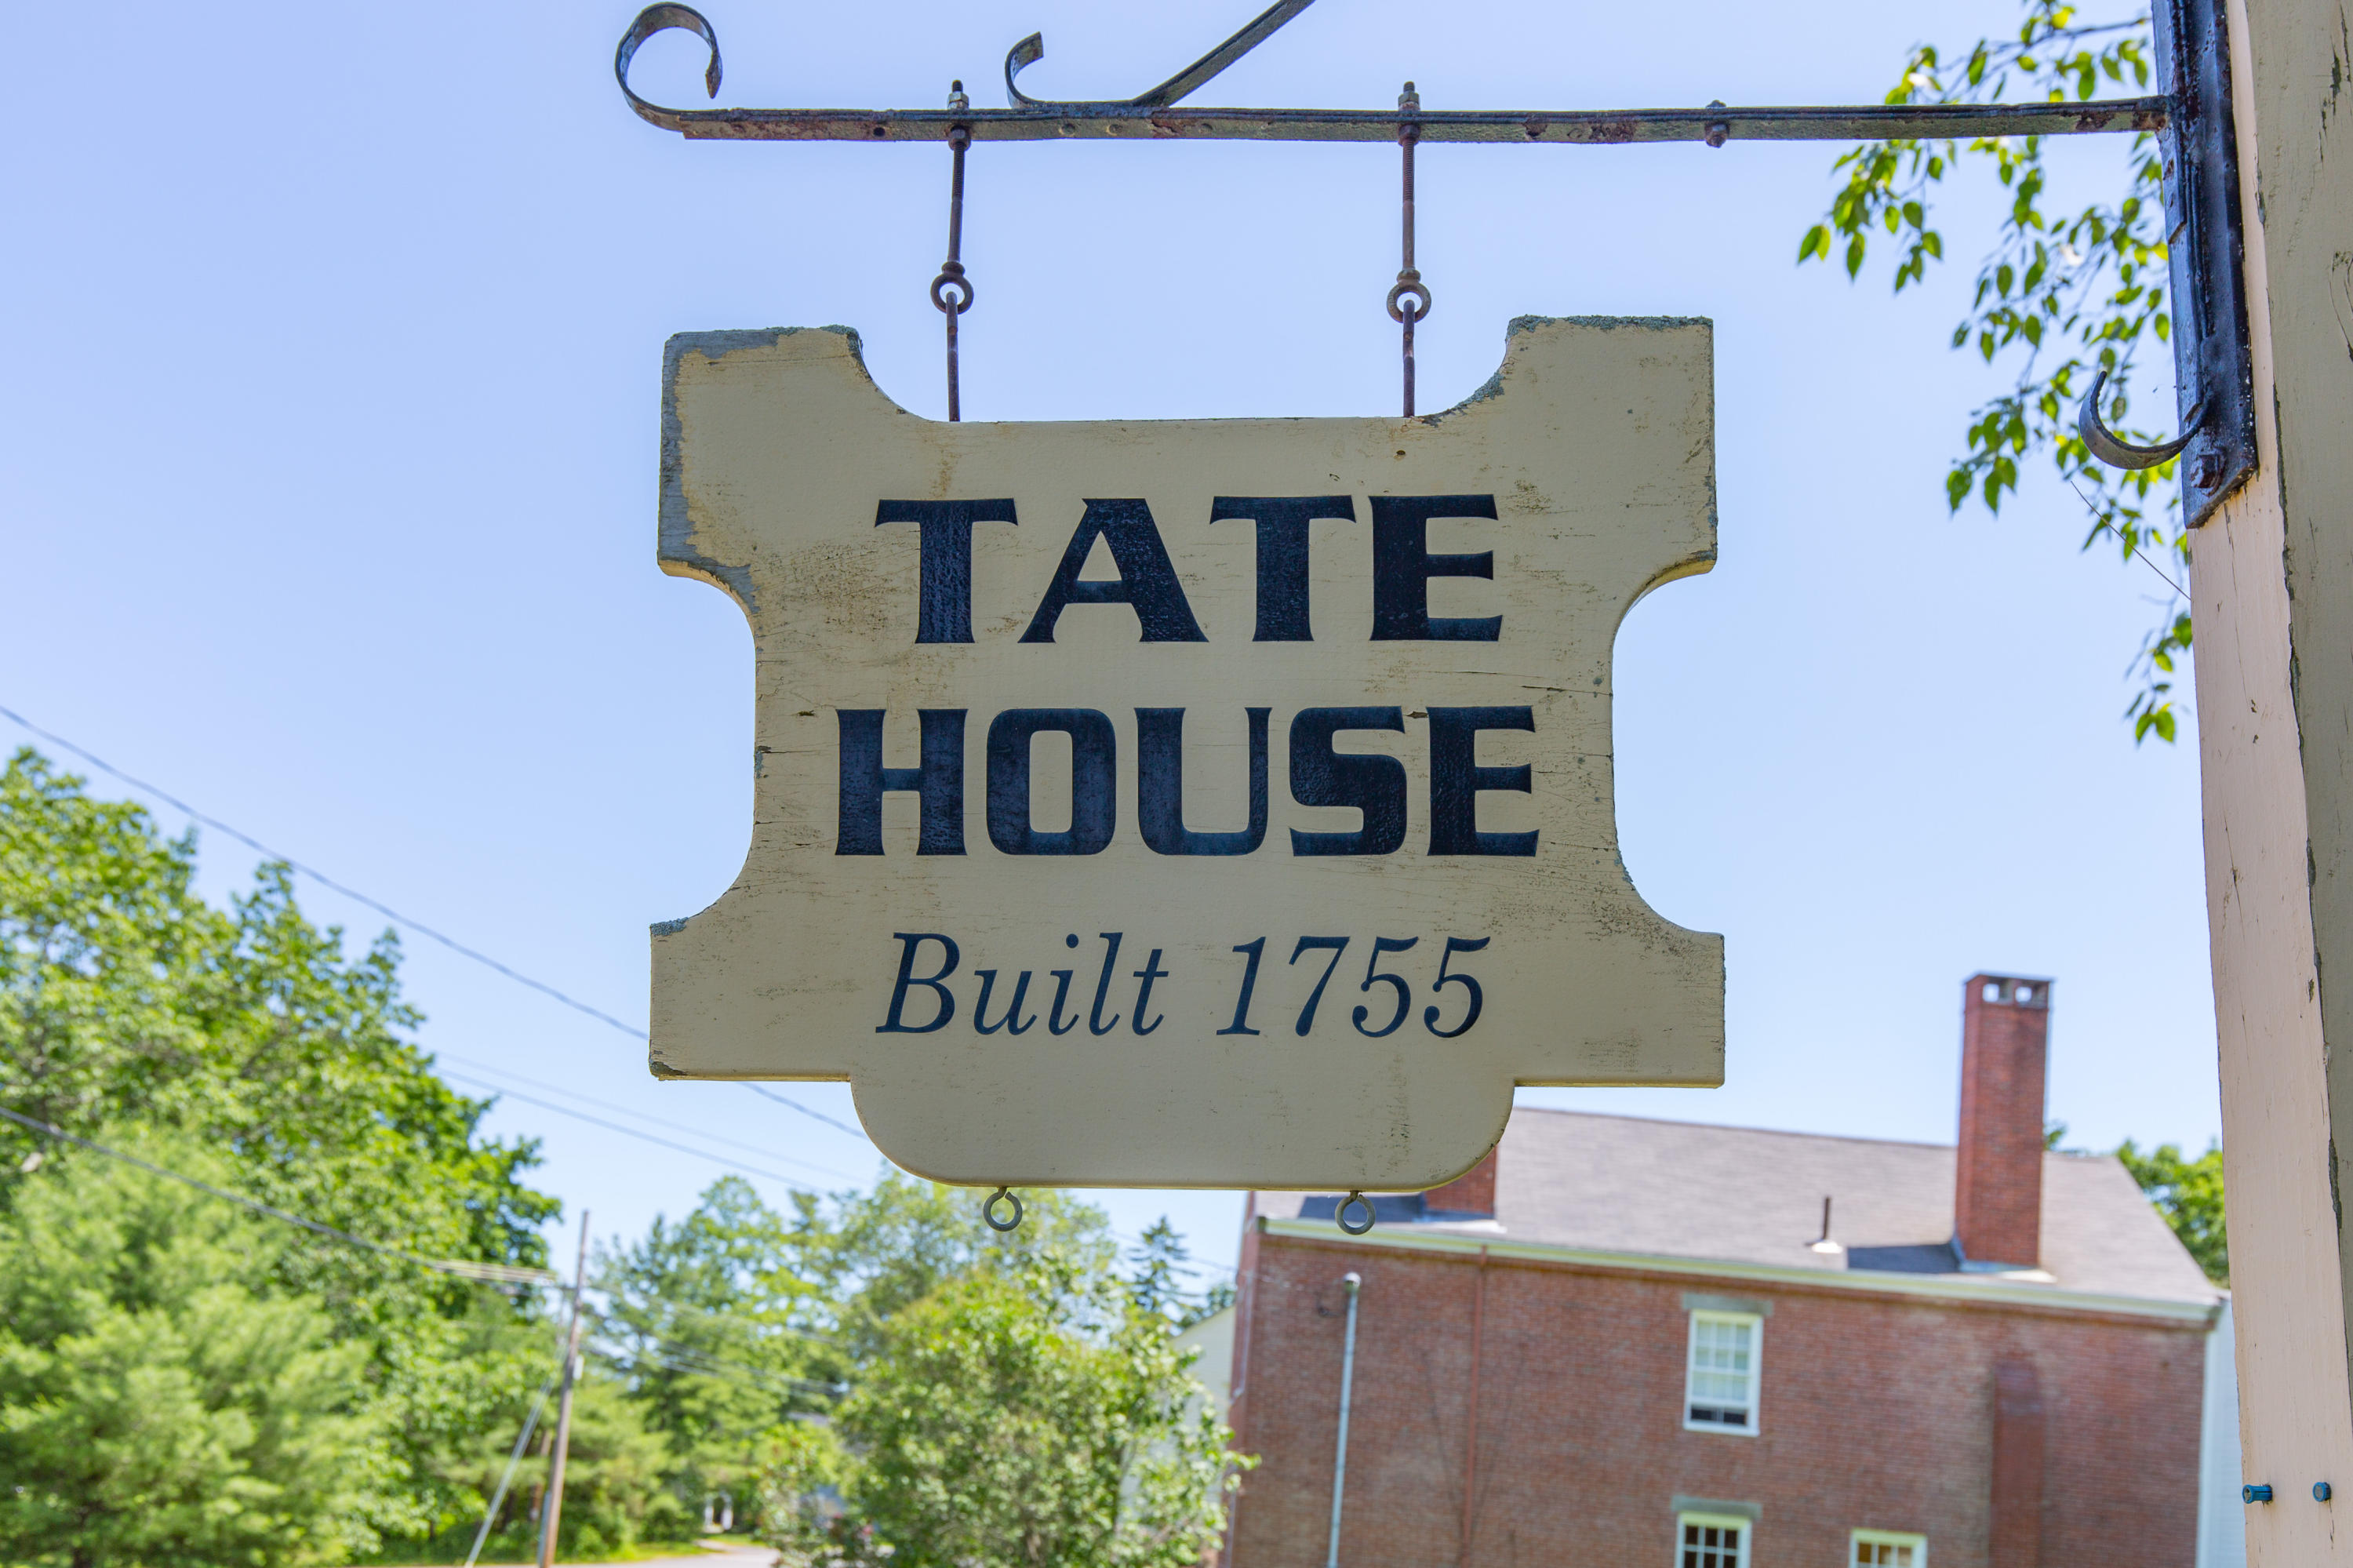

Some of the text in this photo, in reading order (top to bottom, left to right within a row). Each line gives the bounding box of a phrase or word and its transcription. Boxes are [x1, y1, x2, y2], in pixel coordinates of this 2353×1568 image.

[875, 494, 1500, 643] TATE
[836, 706, 1540, 857] HOUSE
[875, 932, 1490, 1038] Built 1755
